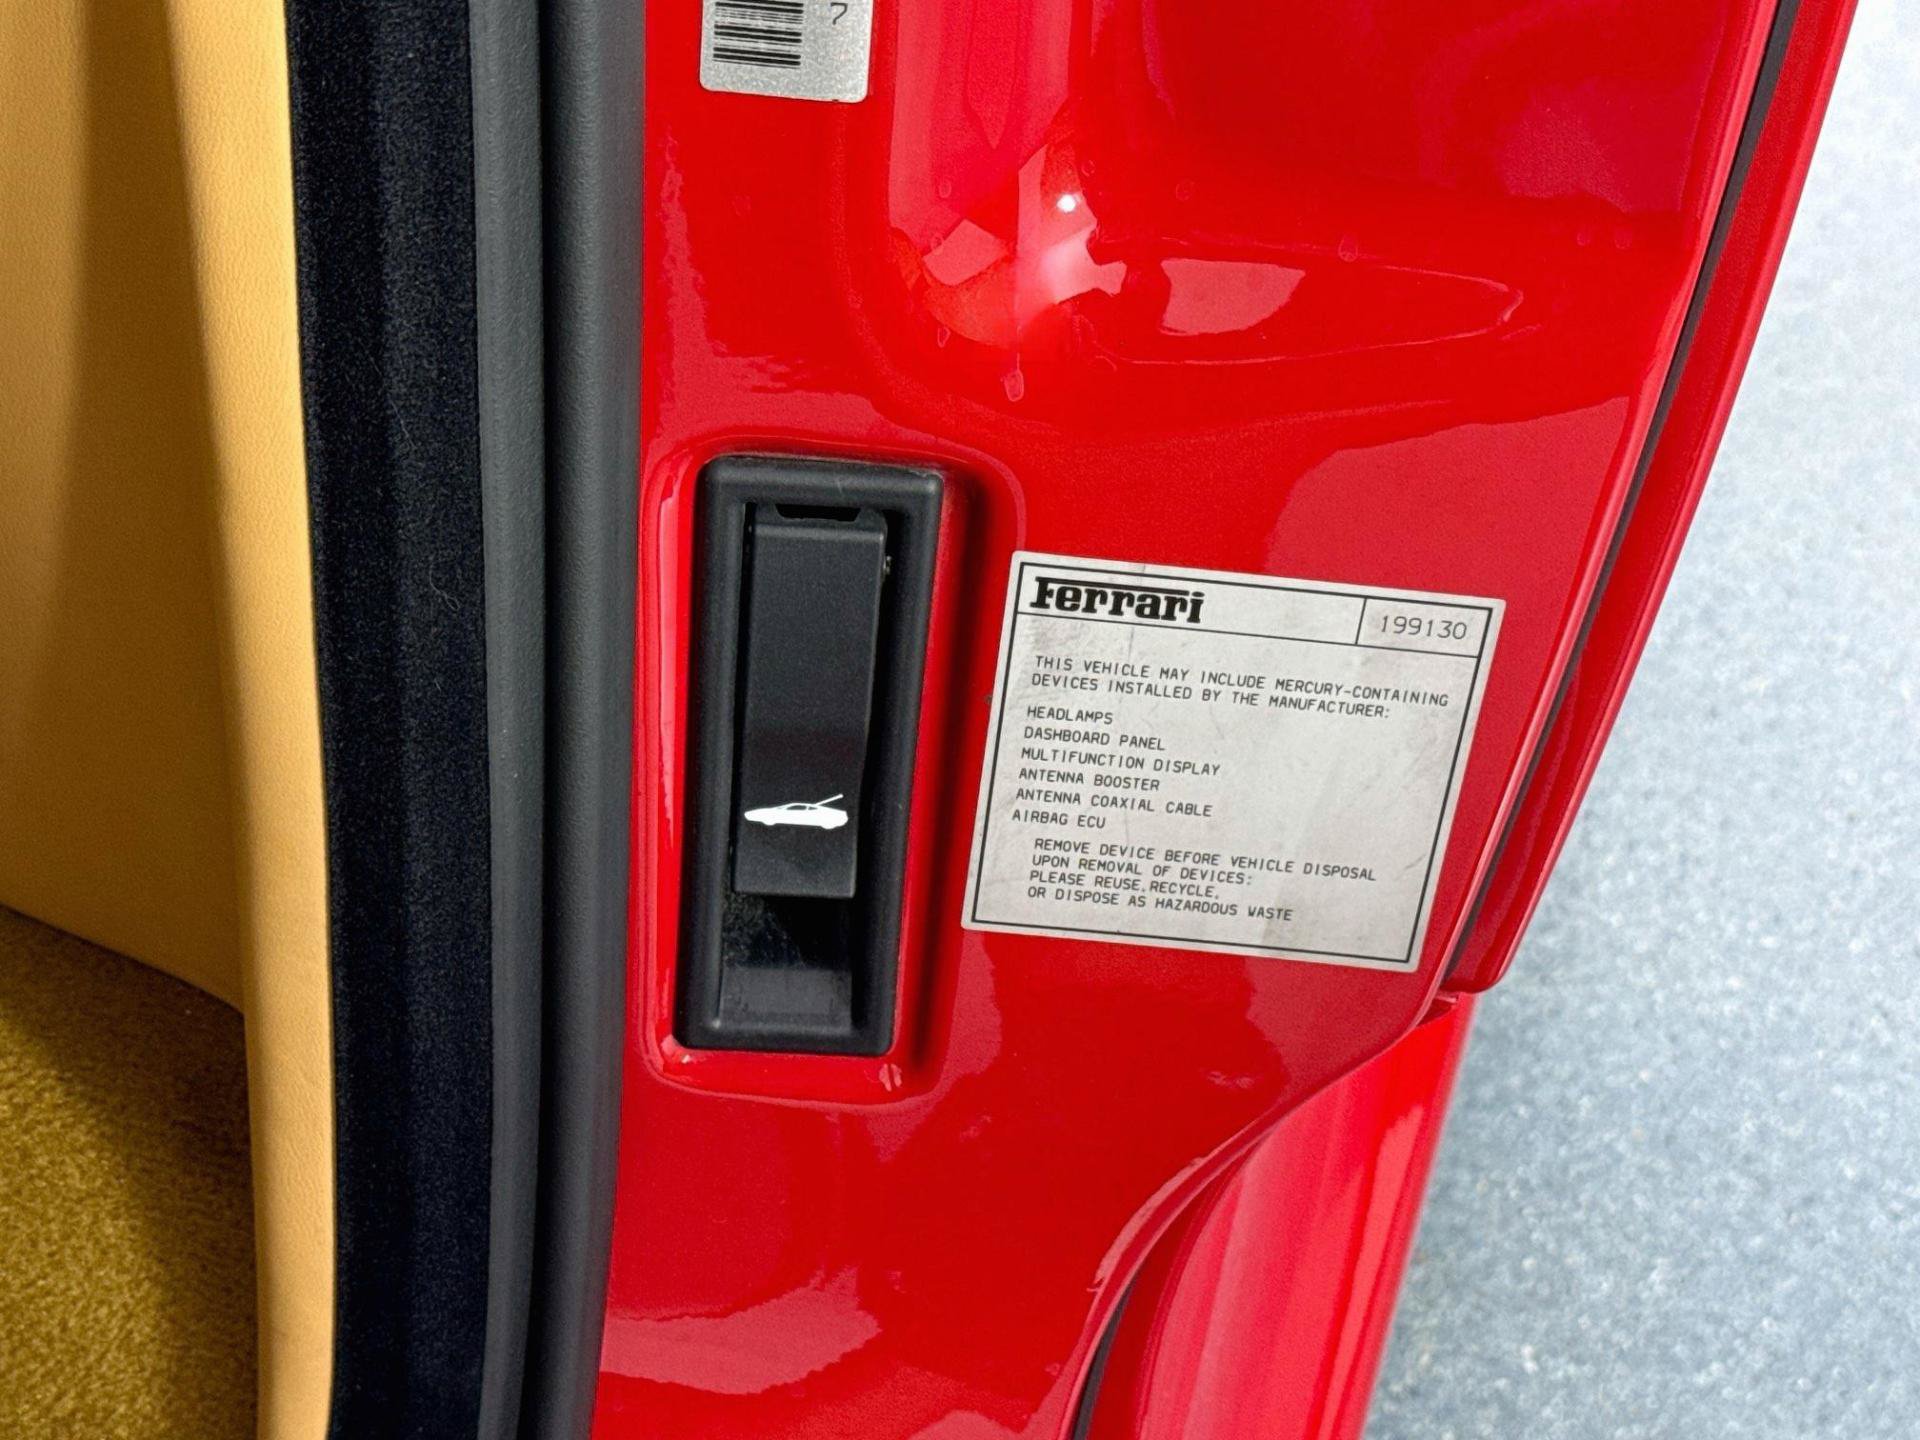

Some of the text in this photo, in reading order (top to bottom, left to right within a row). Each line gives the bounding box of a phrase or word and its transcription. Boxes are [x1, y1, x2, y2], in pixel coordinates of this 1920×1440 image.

[1029, 576, 1204, 624] Ferrari
[1380, 615, 1468, 640] 199130
[1031, 672, 1390, 719] DEVICES INSTALLED BY THE MANUFACTURER:
[1035, 654, 1449, 707] THIS VEHICLE MAY INCLUDE MERCURY-CONTAINING
[1026, 705, 1113, 725] HEADLAMPS
[1023, 725, 1166, 751] DASHBOARD PANEL
[1020, 746, 1221, 776] MULTIFUNCTION DISPLAY
[1018, 767, 1161, 791] ANTENNA BOOSTER
[1015, 787, 1213, 818] ANTENNA COAXIAL CABLE
[1011, 808, 1106, 829] AIRBAG ECU
[1031, 854, 1252, 885] UPON REMOVAL OF DEVICES:
[1033, 837, 1376, 882] REMOVE DEVICE BEFORE VEHICLE DISPOSAL
[1029, 869, 1086, 886] PLEASE
[1027, 885, 1293, 922] OR DISPOSE AS HAZARDOUS WASTE
